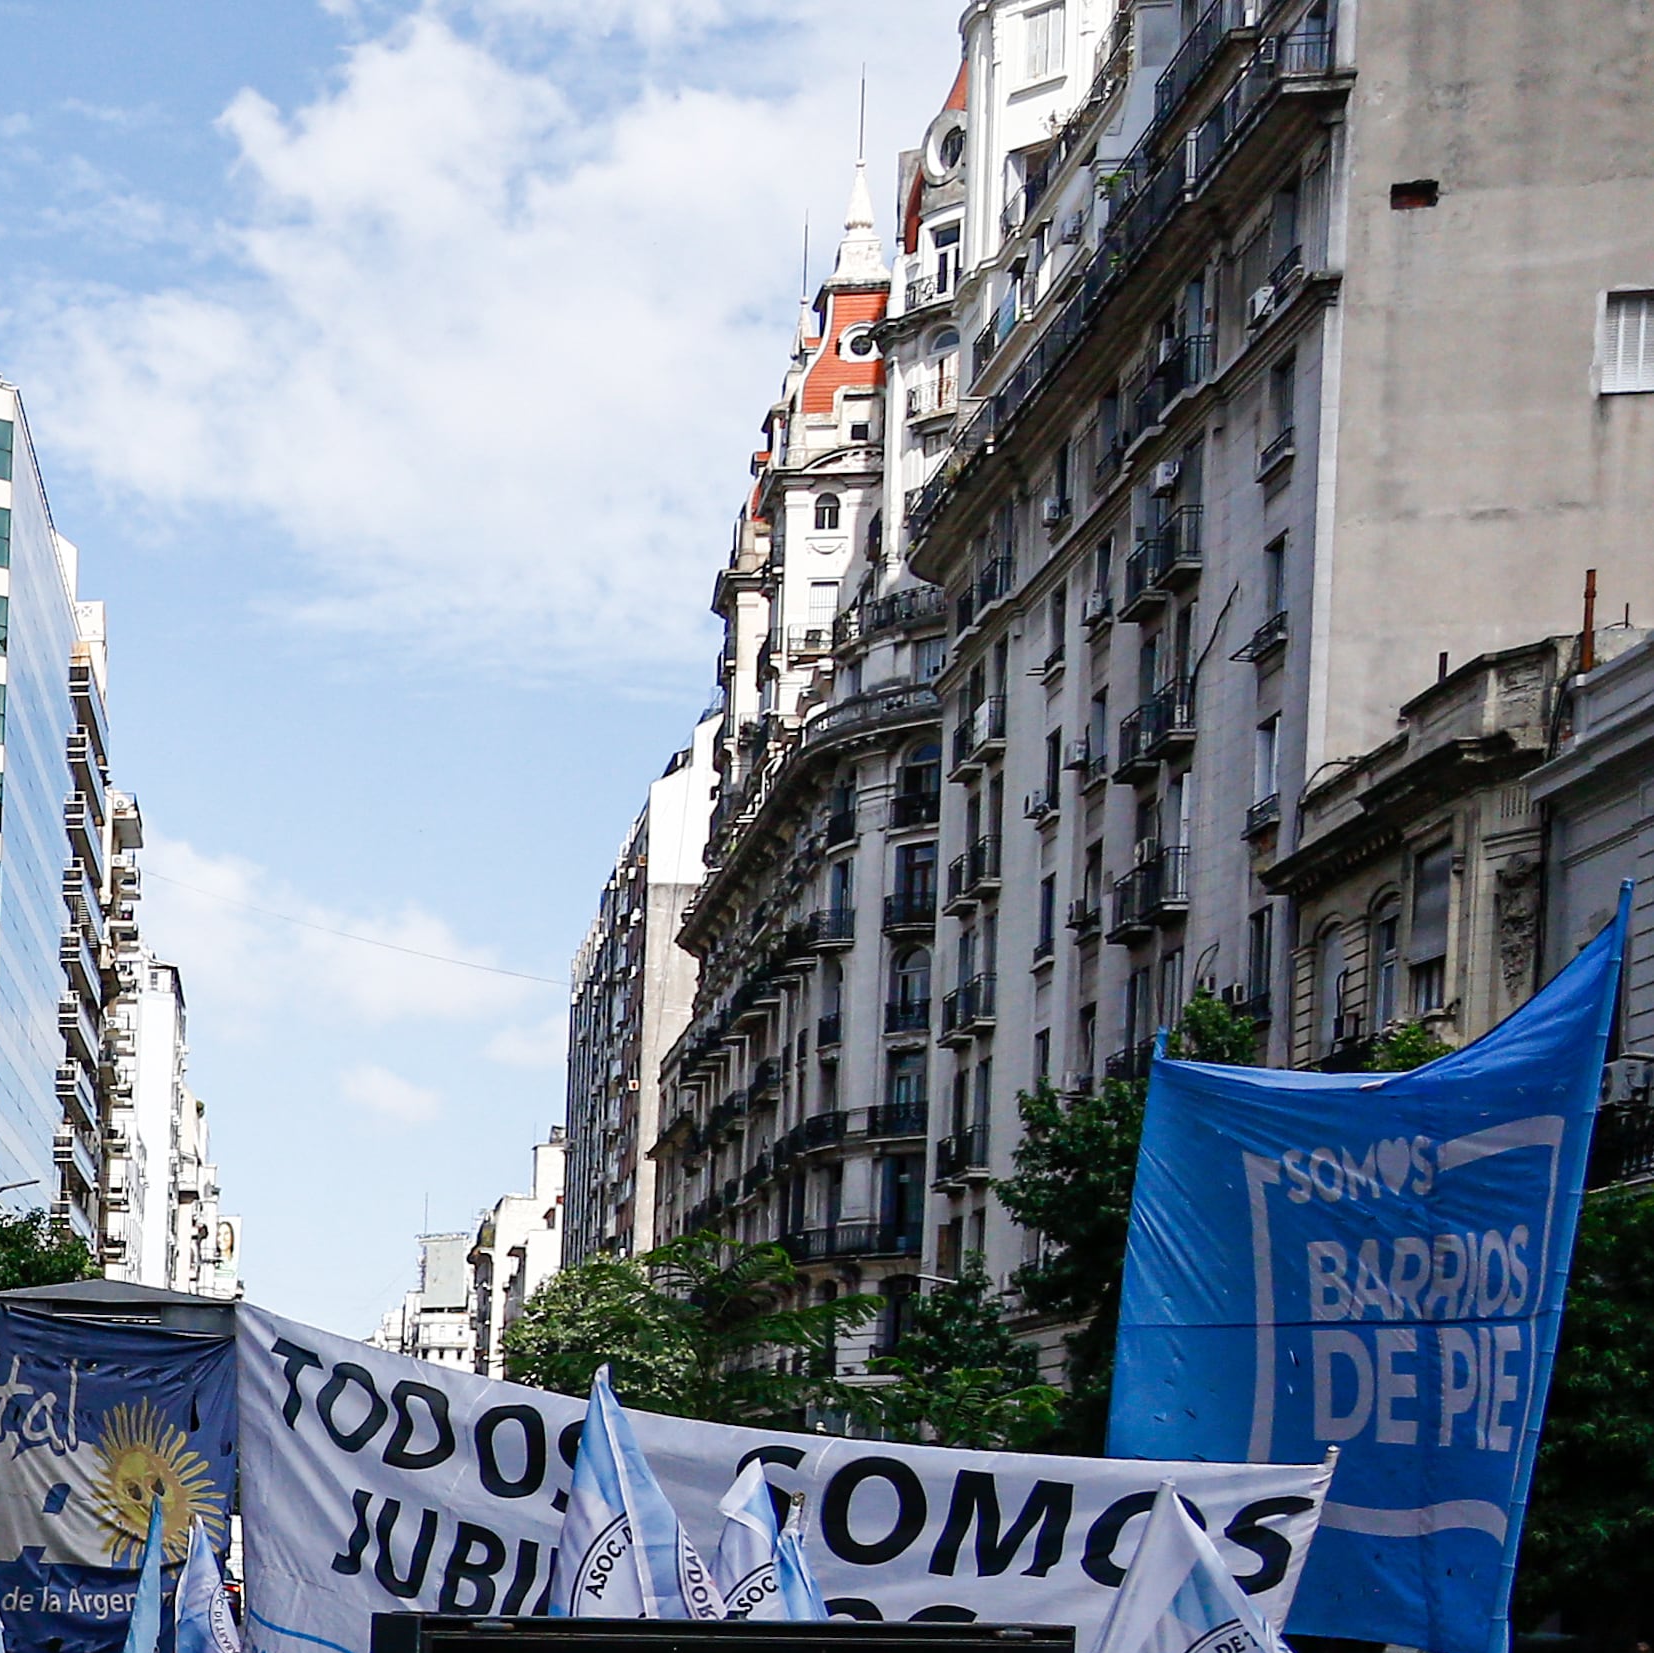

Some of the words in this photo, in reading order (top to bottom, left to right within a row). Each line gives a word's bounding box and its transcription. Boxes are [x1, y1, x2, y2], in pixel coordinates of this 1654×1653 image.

[1307, 1223, 1530, 1322] BARRIOS
[1311, 1326, 1419, 1446] DE
[1439, 1325, 1522, 1453] PIE
[0, 1584, 35, 1613] de
[40, 1586, 62, 1614] la
[585, 1539, 627, 1600] ASOC.
